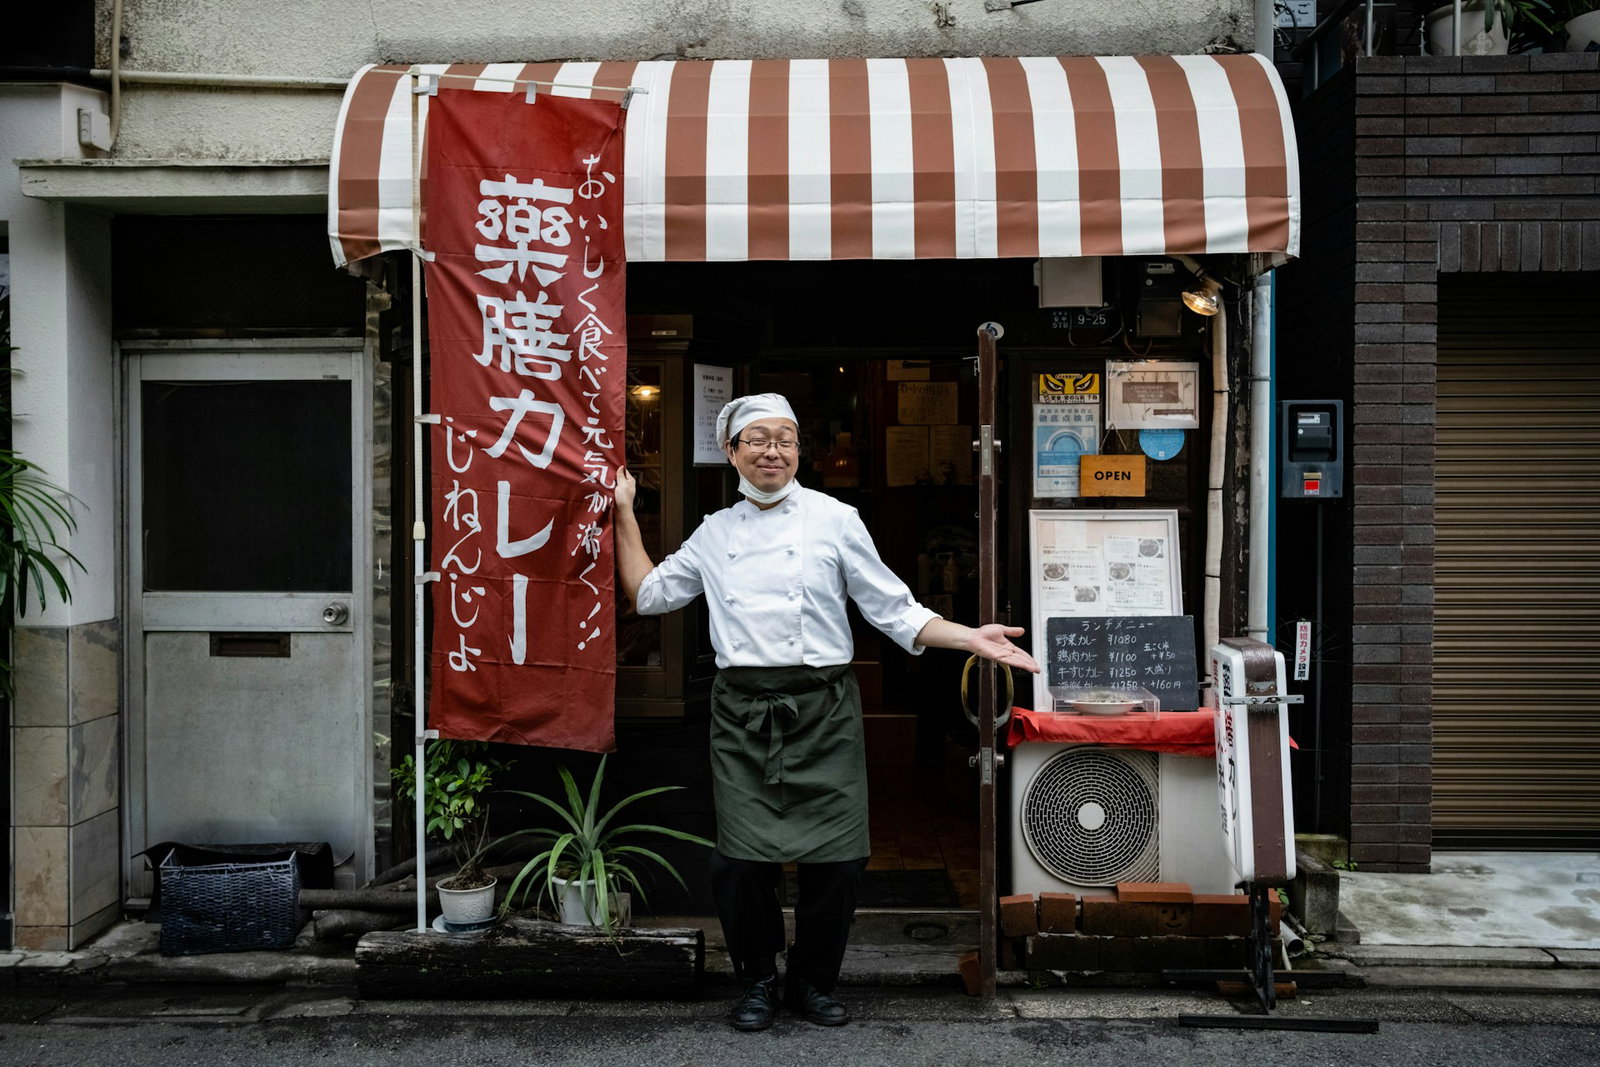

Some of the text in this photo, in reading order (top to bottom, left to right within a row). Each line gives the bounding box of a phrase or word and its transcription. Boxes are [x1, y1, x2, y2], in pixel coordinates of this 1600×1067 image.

[1077, 314, 1106, 325] 9-25
[1094, 471, 1131, 481] OPEN
[1082, 619, 1154, 632] ランチメニュー
[1055, 633, 1097, 646] 野菜カレー
[1057, 650, 1138, 663] 鶏肉カレー ¥1100
[1297, 624, 1308, 678] 防犯カメラ設置
[1057, 665, 1138, 679] 牛すじカレー ¥1250
[1145, 664, 1172, 676] 大盛り
